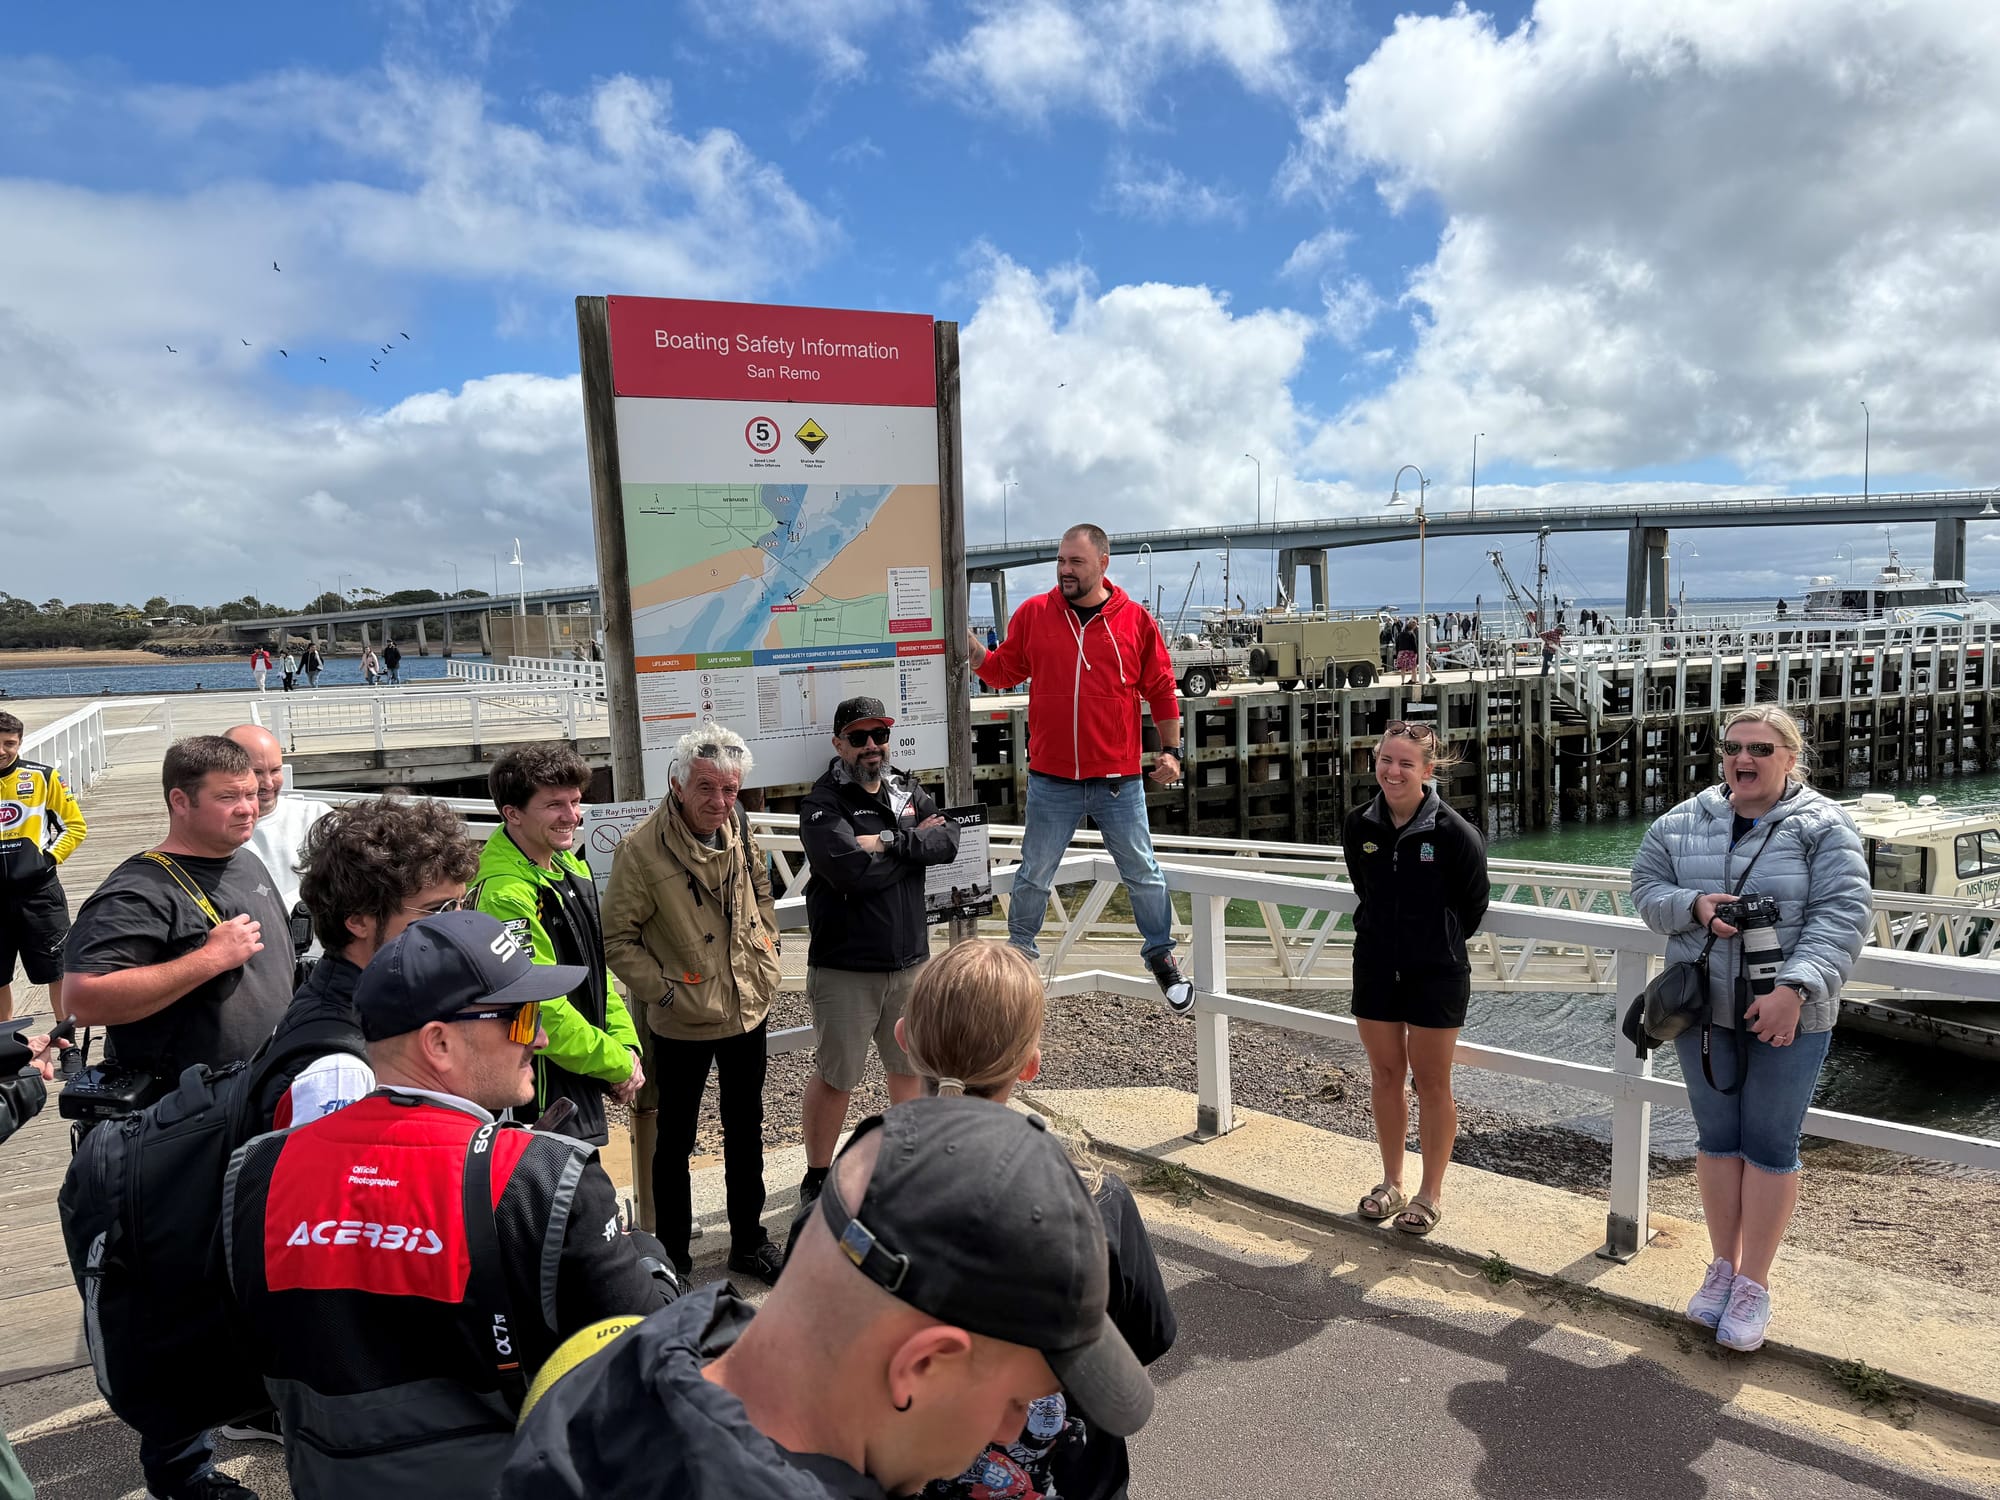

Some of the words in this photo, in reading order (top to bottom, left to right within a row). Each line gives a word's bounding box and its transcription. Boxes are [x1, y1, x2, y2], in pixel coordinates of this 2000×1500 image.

[654, 329, 729, 356] Boating
[735, 333, 795, 359] Safety
[801, 338, 900, 360] Information
[747, 364, 775, 379] San
[779, 366, 821, 381] Remo
[756, 423, 769, 441] 5
[900, 738, 915, 747] 000
[605, 808, 620, 816] Ray
[621, 804, 647, 815] Fishing
[953, 814, 981, 824] DATE
[1966, 882, 1982, 896] MSV
[352, 1165, 378, 1174] Official
[348, 1175, 400, 1188] Photographer
